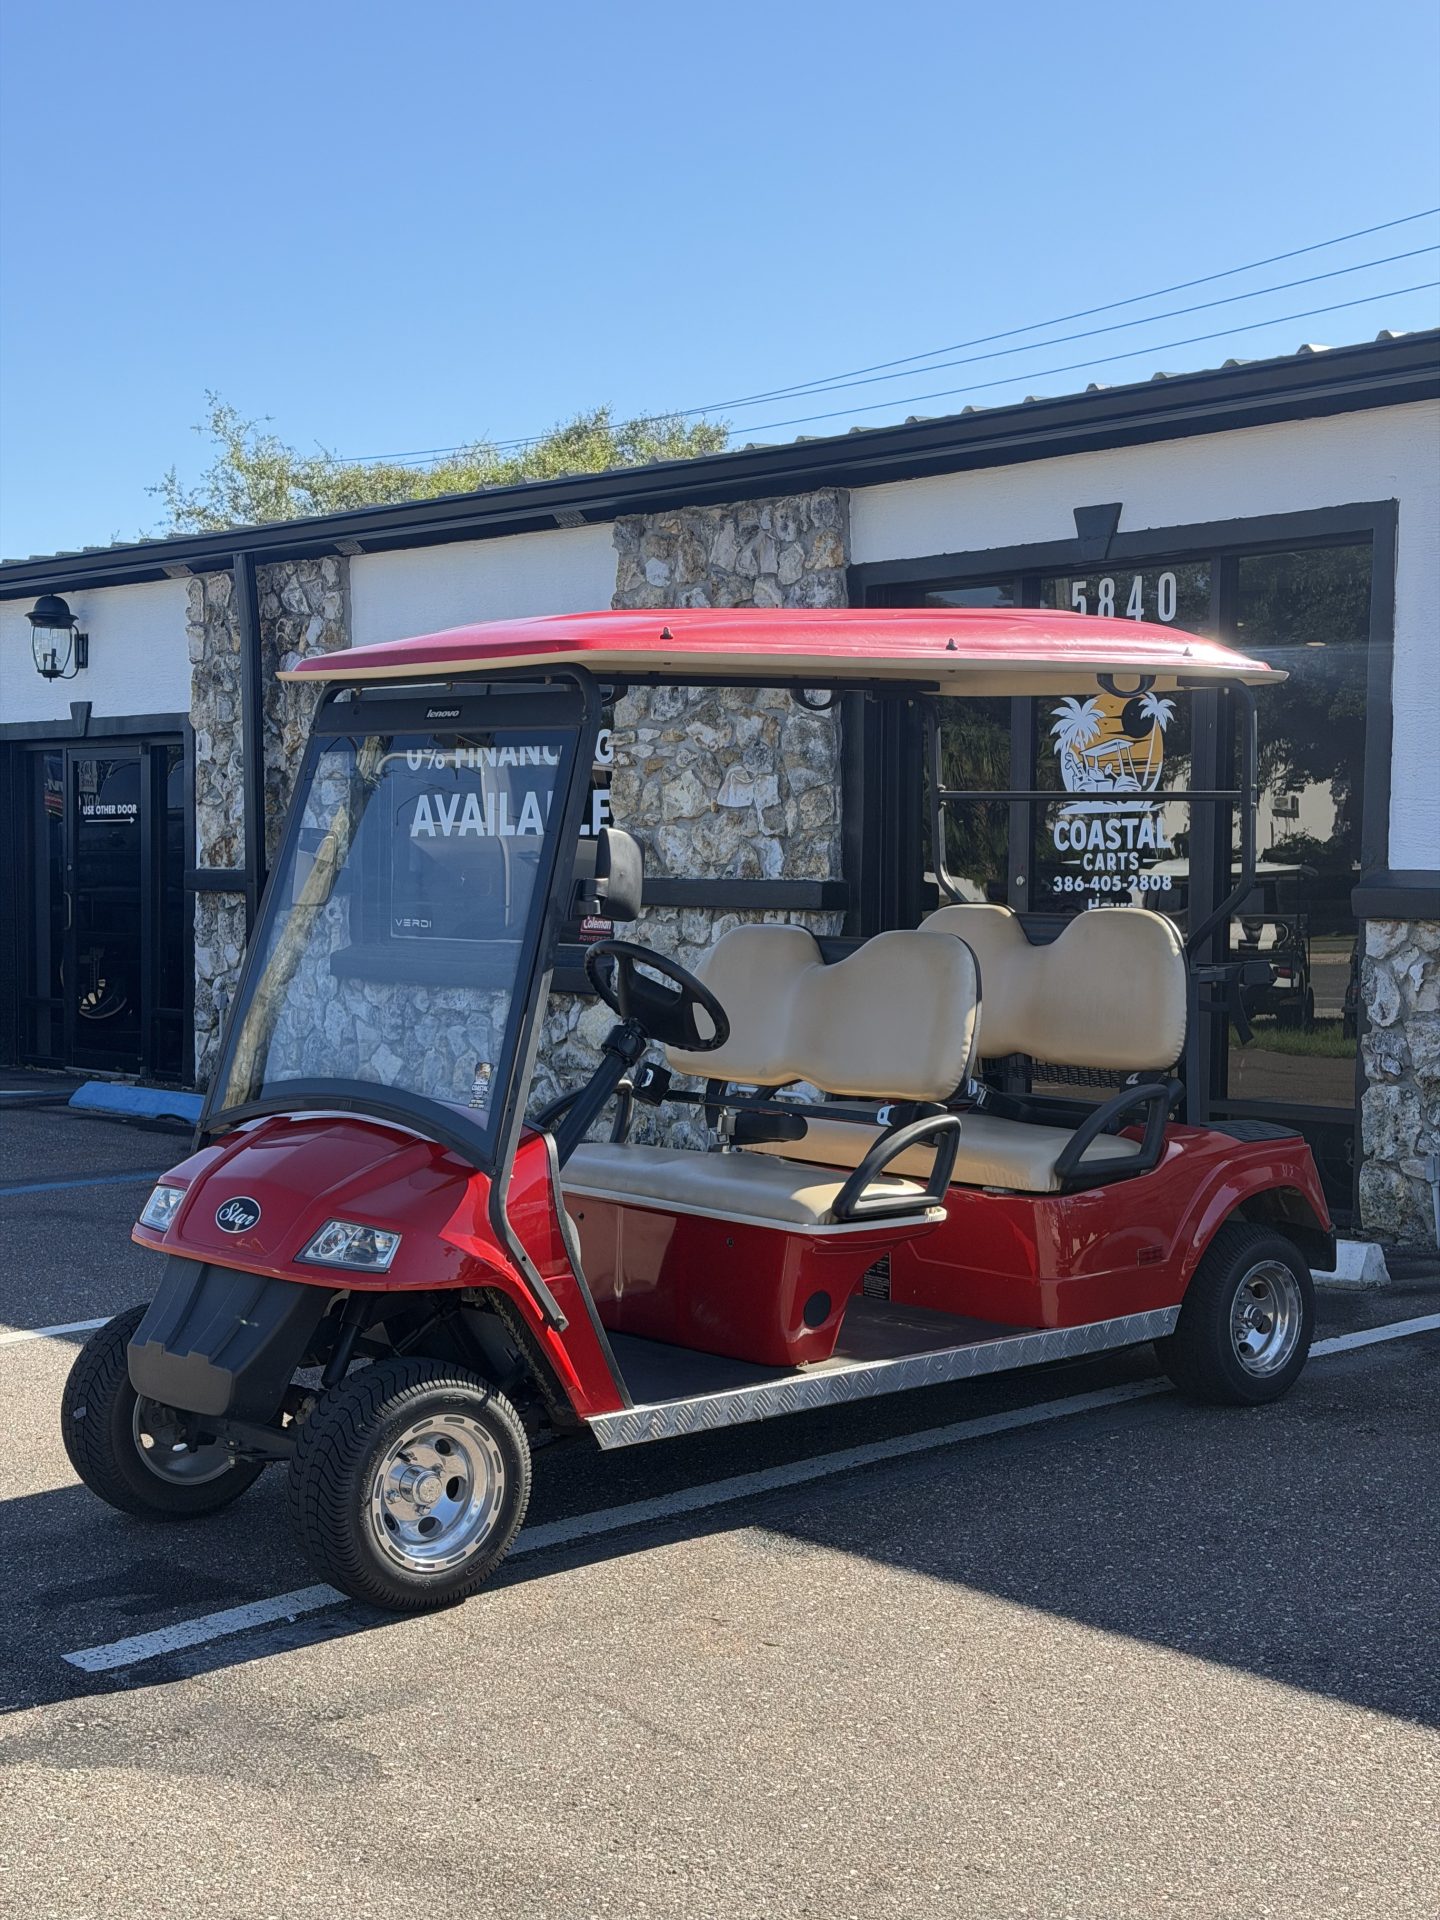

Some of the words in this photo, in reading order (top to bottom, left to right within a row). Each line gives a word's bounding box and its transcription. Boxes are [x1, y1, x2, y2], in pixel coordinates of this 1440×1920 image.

[1071, 572, 1177, 622] 5840
[426, 709, 460, 718] lenovo
[455, 729, 614, 769] FINANCG
[82, 805, 95, 815] USE
[96, 805, 116, 815] OTHER
[117, 804, 137, 814] DOOR
[410, 789, 610, 837] AVAILAE
[1053, 818, 1171, 851] COASTAL
[1083, 852, 1139, 871] CARTS
[1053, 875, 1172, 892] 386-405-2808
[394, 918, 432, 928] VERDI
[219, 1202, 255, 1226] Star
